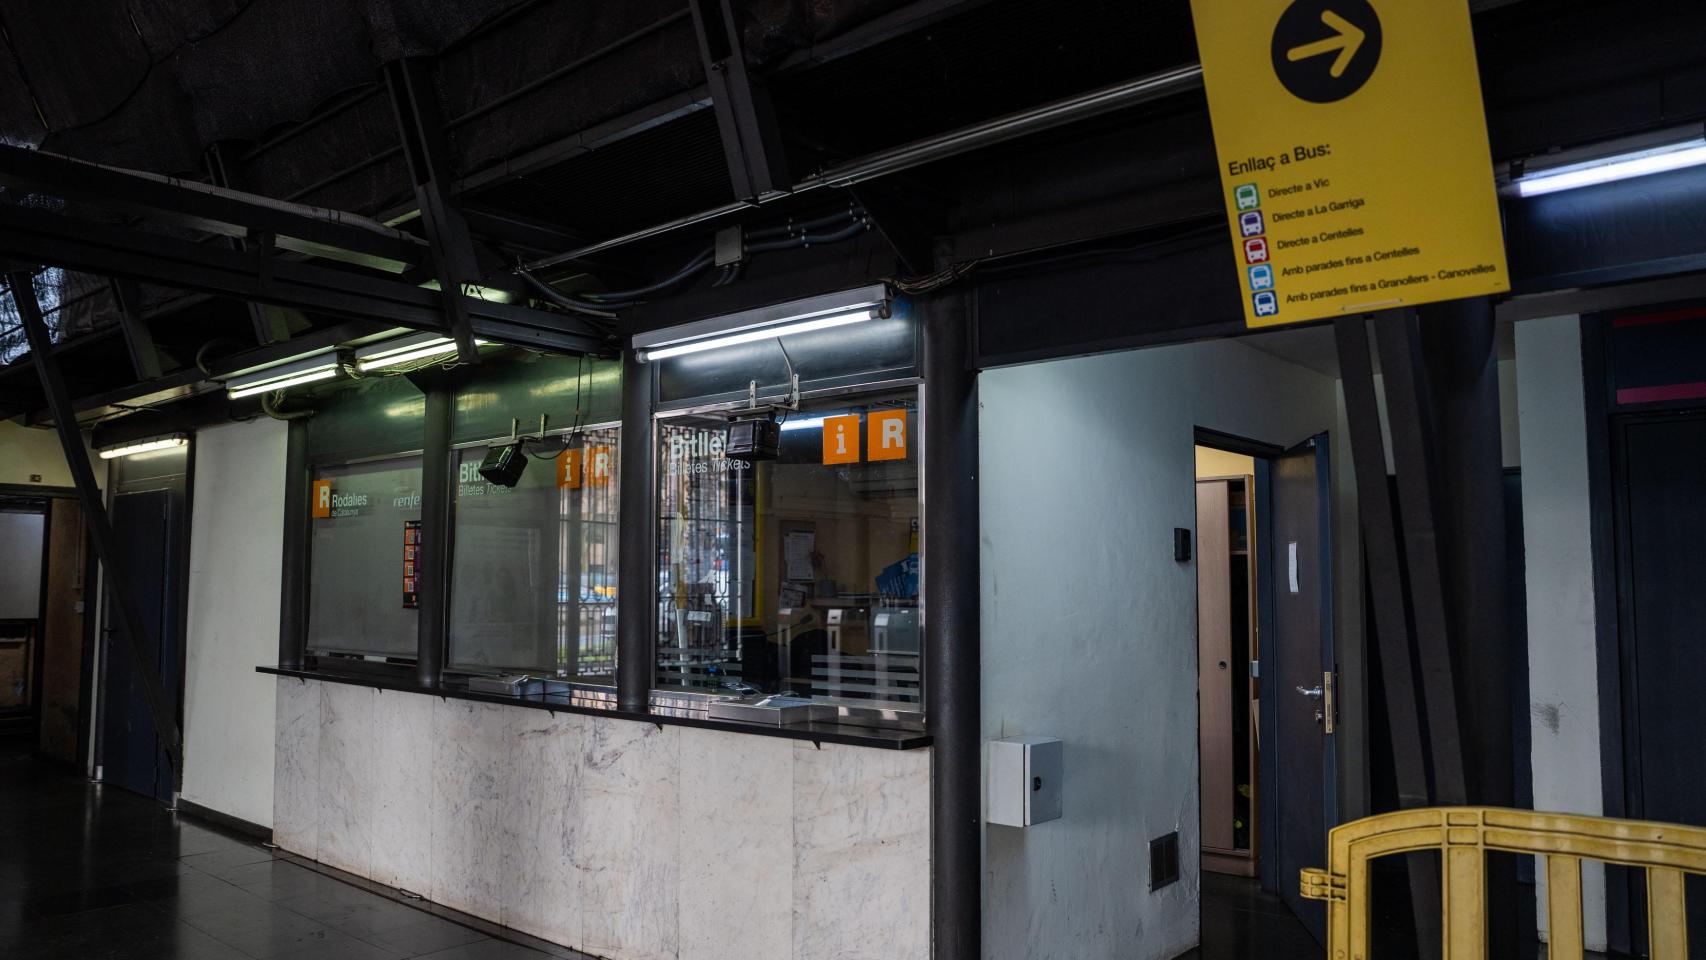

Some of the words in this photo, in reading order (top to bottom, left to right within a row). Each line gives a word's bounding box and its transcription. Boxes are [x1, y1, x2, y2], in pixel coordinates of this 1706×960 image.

[1228, 156, 1276, 176] Enllaç
[1280, 153, 1290, 165] a
[1294, 143, 1331, 162] Bus:
[1268, 184, 1303, 198] Directe
[1305, 182, 1312, 190] a
[1313, 178, 1330, 189] Vic
[1272, 209, 1305, 223] Directe
[1307, 208, 1314, 216] a
[1315, 205, 1327, 215] La
[1329, 198, 1365, 211] Garriga
[1277, 236, 1310, 249] Directe
[1319, 227, 1364, 242] Centelles
[1281, 265, 1304, 276] Amb
[1306, 259, 1344, 274] parades
[1345, 255, 1363, 266] fins
[1366, 254, 1373, 262] a
[1373, 246, 1420, 261] Centelles
[1286, 292, 1308, 303] Amb
[1310, 286, 1348, 301] parades
[1350, 284, 1368, 294] fins
[1370, 282, 1377, 290] a
[1378, 274, 1429, 289] Granollers
[1437, 263, 1496, 280] Canovelles
[670, 430, 727, 459] Bitllet
[836, 424, 847, 454] i
[882, 418, 904, 448] R
[594, 453, 608, 478] R
[669, 460, 708, 476] Billetes
[712, 457, 751, 472] Tickets
[319, 486, 331, 509] R
[332, 493, 367, 508] Rodalies
[393, 491, 421, 509] renfe
[458, 484, 485, 497] Billetes
